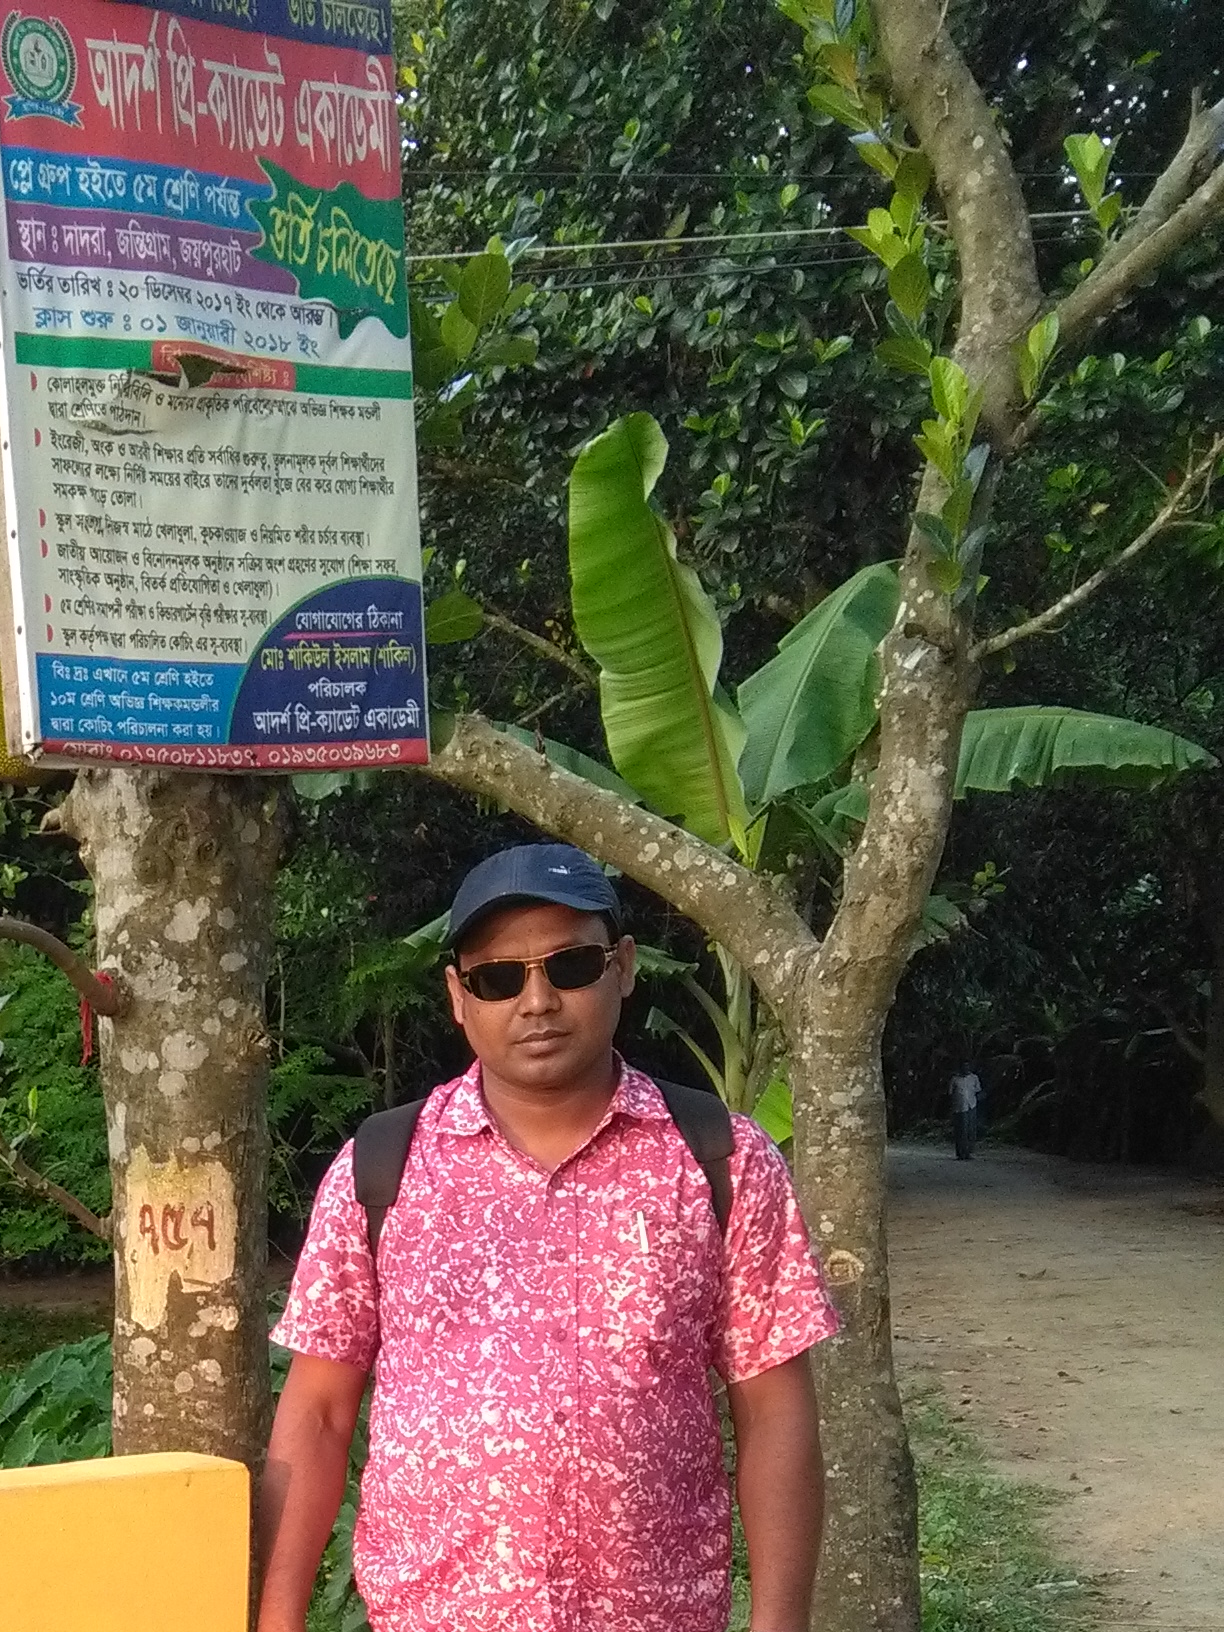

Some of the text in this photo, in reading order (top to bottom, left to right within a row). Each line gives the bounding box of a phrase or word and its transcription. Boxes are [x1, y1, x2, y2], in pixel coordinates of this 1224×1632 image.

[85, 10, 162, 134] আদর্শ
[295, 55, 392, 172] একাডেমী
[76, 157, 126, 201] হইতে
[134, 174, 158, 204] ৫ম
[119, 281, 139, 302] ২০
[196, 290, 232, 314] ২০১৭
[236, 292, 253, 322] ইং
[255, 300, 286, 322] থেকে
[140, 314, 168, 333] ০১
[244, 329, 291, 353] ২০১৮
[297, 331, 320, 358] ইং
[131, 671, 150, 685] ৫ম
[308, 677, 367, 698] পরিচালক
[253, 702, 291, 734] আদর্শ
[364, 699, 420, 730] একাডেমী
